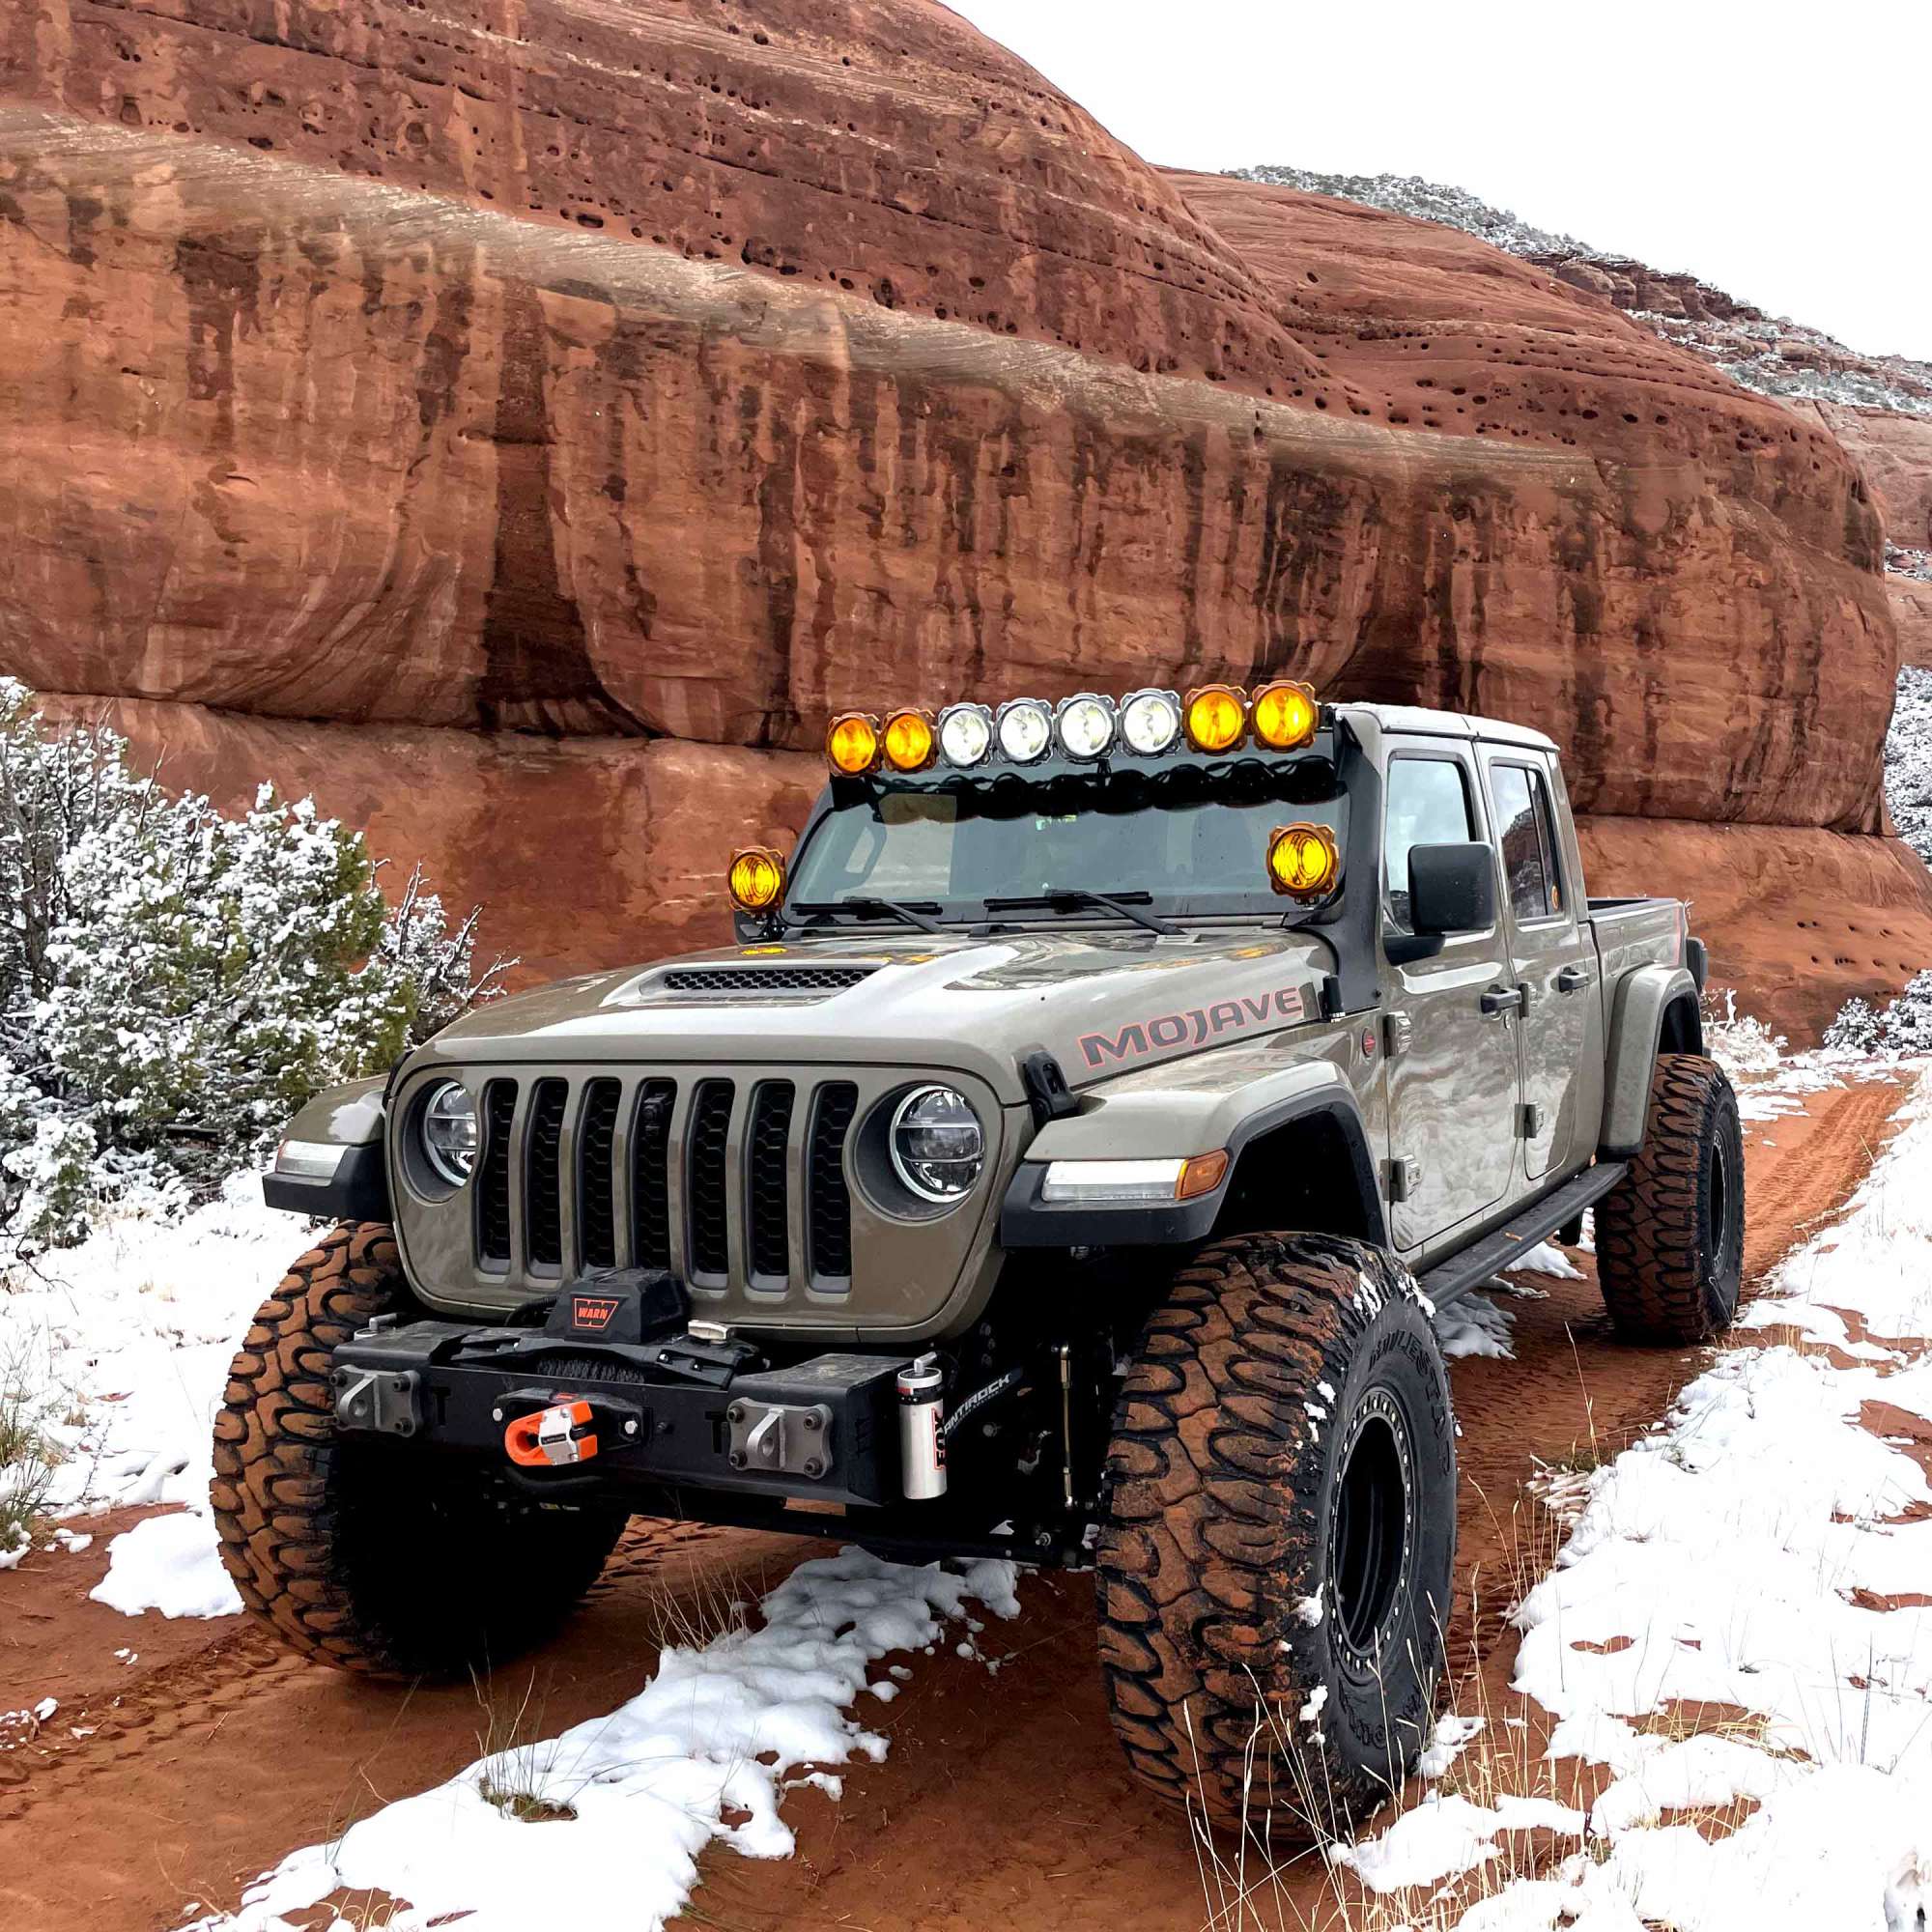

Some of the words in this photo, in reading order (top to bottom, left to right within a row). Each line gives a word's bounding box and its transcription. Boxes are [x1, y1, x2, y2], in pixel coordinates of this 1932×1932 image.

[735, 857, 772, 902] KC
[1276, 834, 1322, 886] KC
[1078, 986, 1303, 1068] MOJAVE
[578, 1307, 609, 1320] WARN
[943, 1373, 1011, 1435] ANTIROCK
